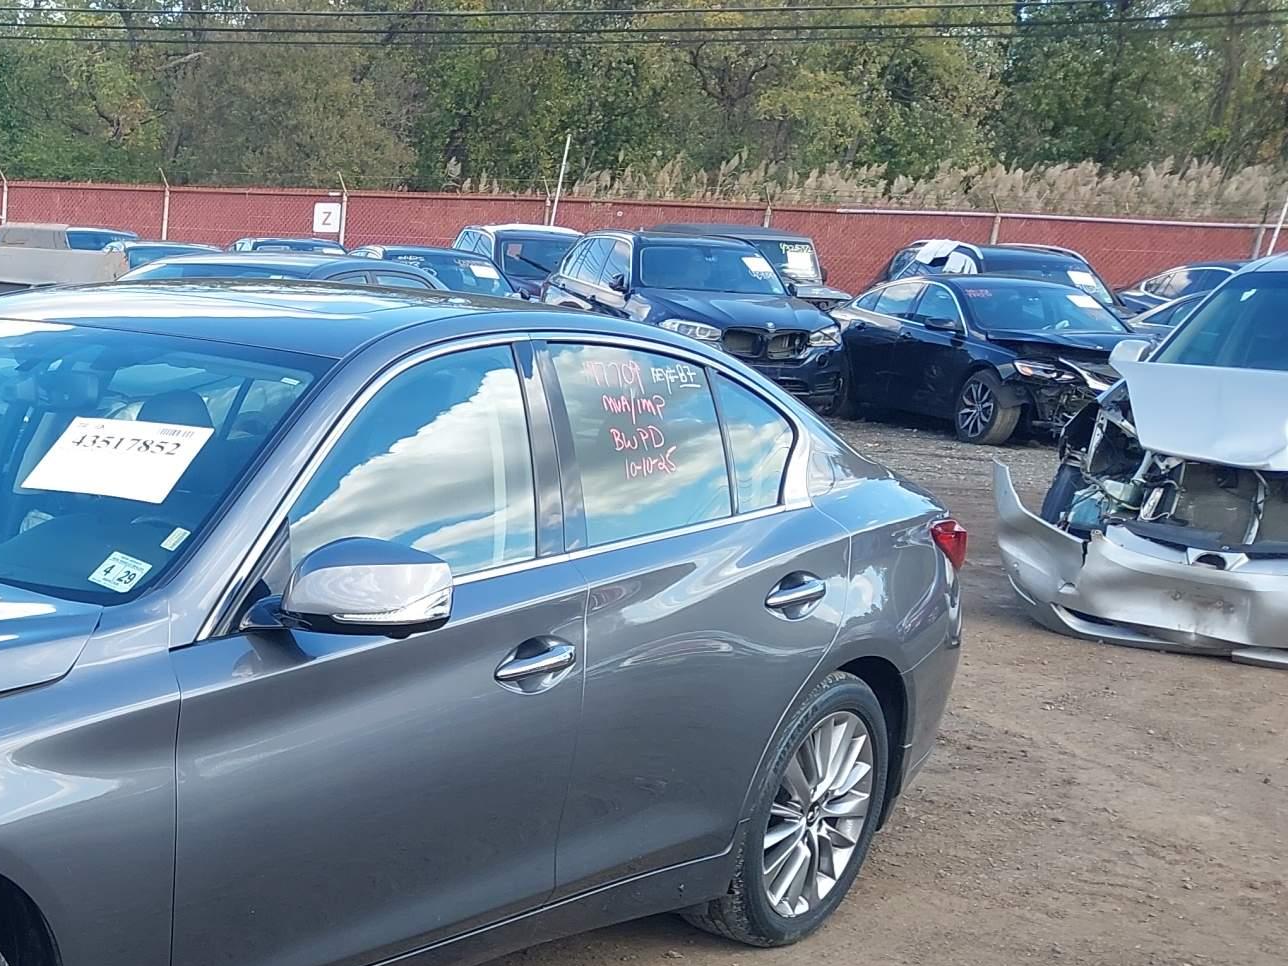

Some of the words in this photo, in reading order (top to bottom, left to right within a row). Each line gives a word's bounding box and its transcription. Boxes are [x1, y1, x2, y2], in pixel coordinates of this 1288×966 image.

[321, 211, 332, 226] Z
[71, 433, 181, 456] 43517852
[625, 446, 677, 479] 10-10-25
[103, 564, 116, 576] 4
[117, 570, 137, 585] 29
